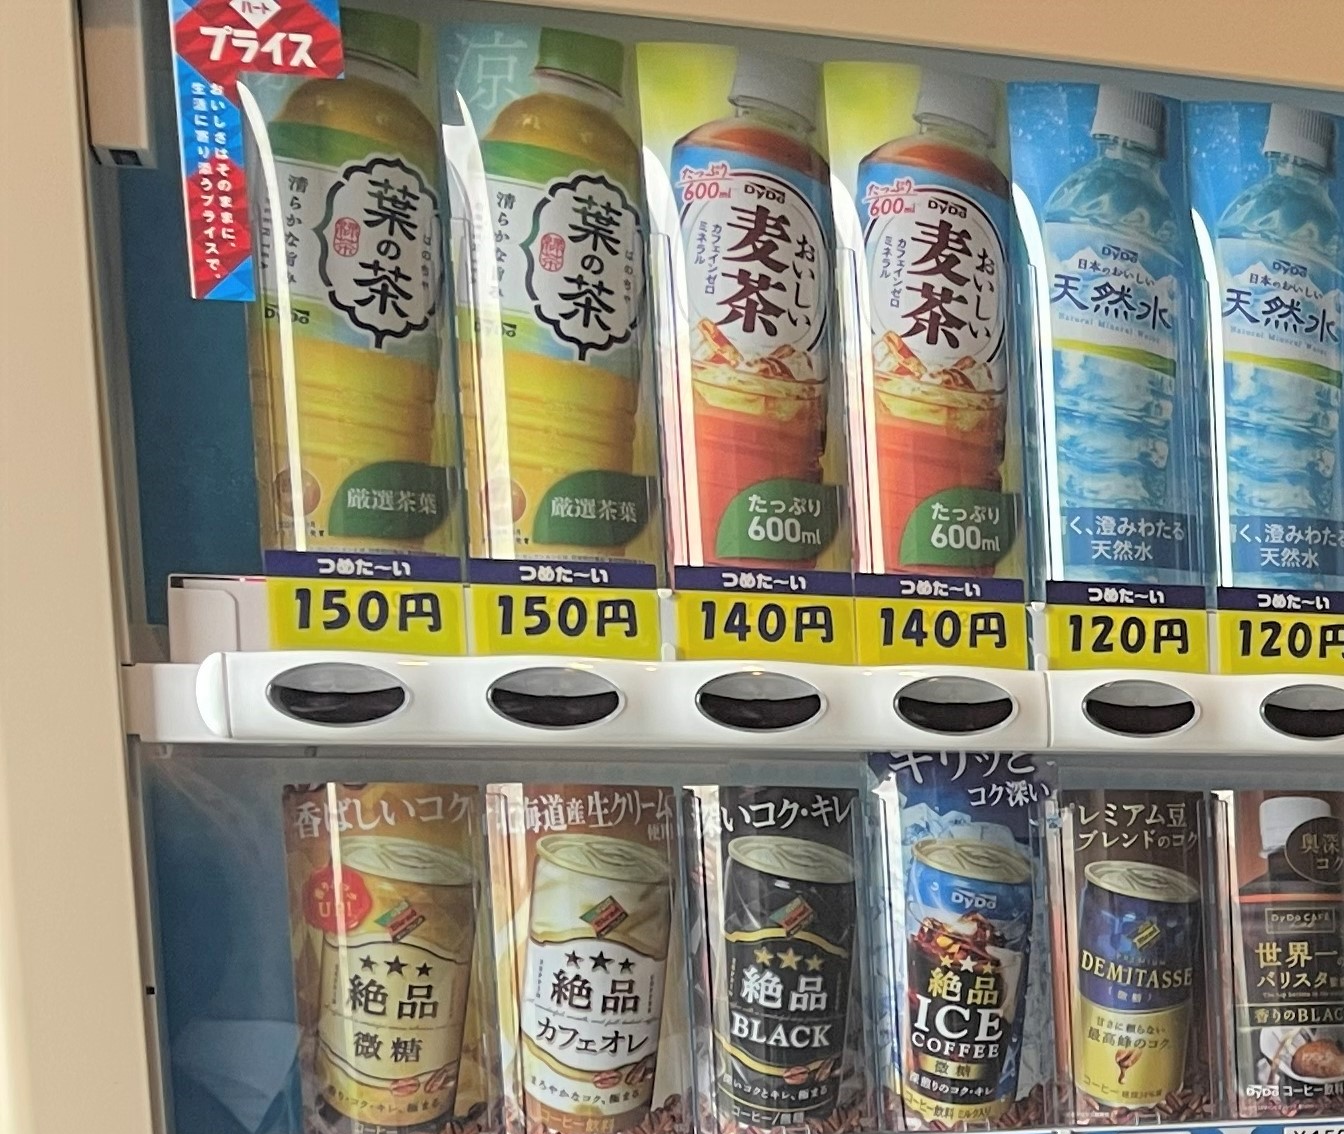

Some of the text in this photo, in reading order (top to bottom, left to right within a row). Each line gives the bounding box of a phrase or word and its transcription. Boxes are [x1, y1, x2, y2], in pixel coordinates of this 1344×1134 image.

[199, 25, 317, 68] プライス
[356, 179, 420, 320] 葉の茶
[566, 194, 622, 335] 葉の茶
[717, 206, 791, 338] 麦茶
[1053, 273, 1173, 332] 天然水
[1222, 288, 1340, 343] 天然水
[346, 489, 438, 516] 厳選茶葉
[748, 494, 822, 517] たっぷり
[748, 516, 822, 546] 600ml
[1090, 540, 1154, 561] 天然水
[1260, 548, 1320, 569] 天然水
[294, 588, 442, 634] 150円
[498, 595, 639, 639] 150円
[700, 601, 835, 644] 140円
[880, 607, 1007, 650] 140円
[1069, 614, 1191, 655] 120円
[968, 782, 1052, 808] コク深い
[1079, 949, 1193, 990] DEMITASSE
[348, 974, 439, 1020] 絶品
[550, 969, 642, 1014] 絶品
[536, 1016, 650, 1056] カフェオレ
[730, 1011, 831, 1049] BLACK
[912, 994, 1004, 1043] ICE
[353, 1031, 423, 1064] 微糖
[911, 1032, 1000, 1060] COFFEE
